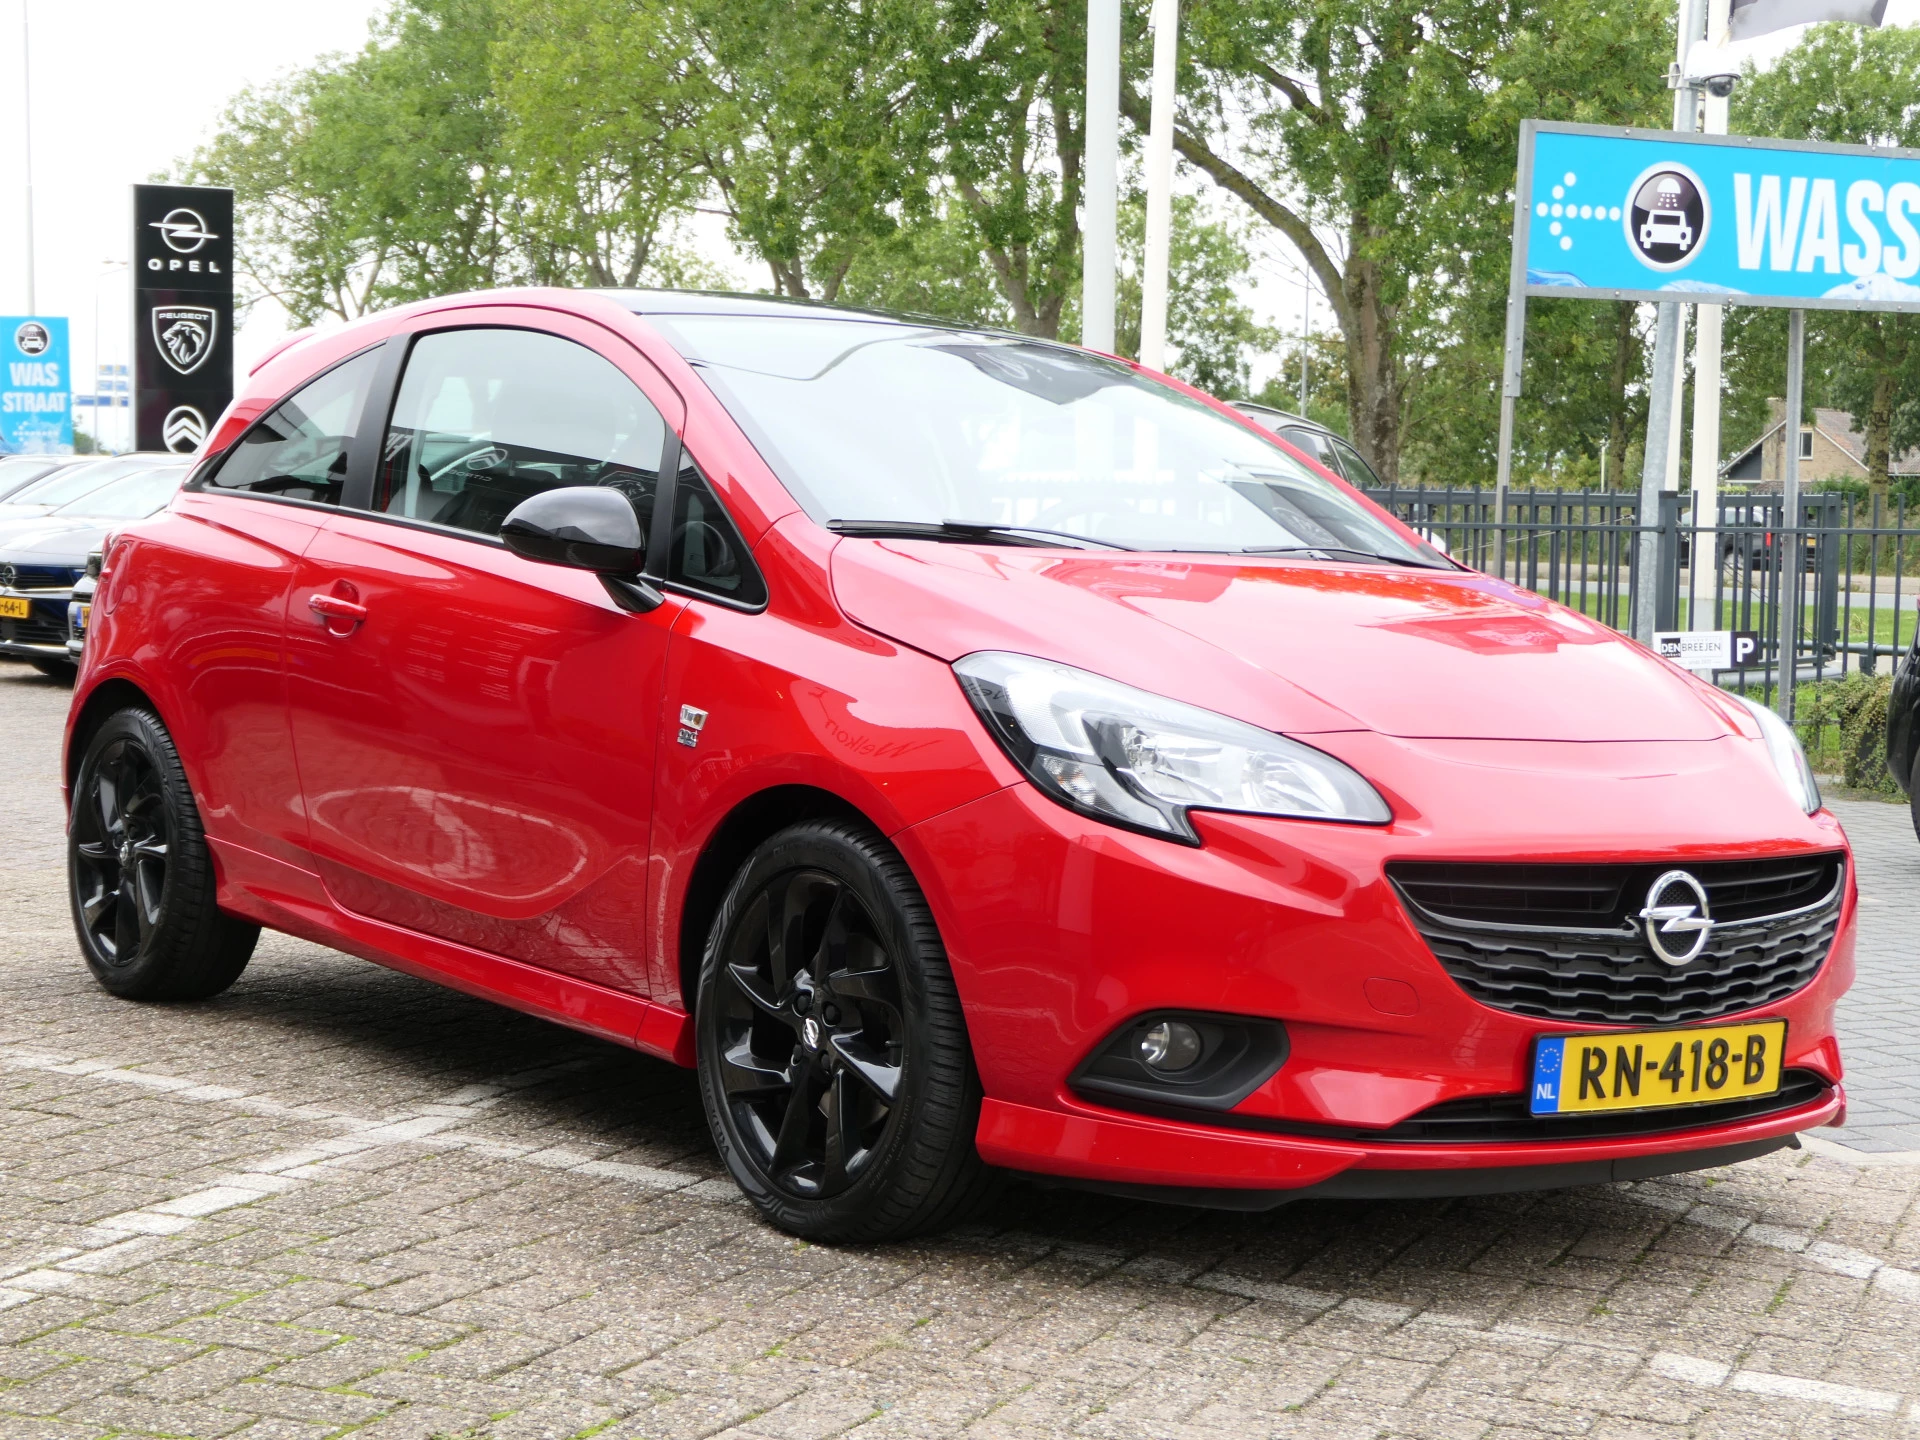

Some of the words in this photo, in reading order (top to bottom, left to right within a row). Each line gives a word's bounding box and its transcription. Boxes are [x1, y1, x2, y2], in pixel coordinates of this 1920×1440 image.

[1733, 173, 1920, 278] WASS
[147, 258, 222, 273] OPEL
[158, 312, 209, 320] PEUGEOT
[9, 361, 60, 387] WAS
[2, 391, 68, 413] STRAAT
[1661, 642, 1681, 653] DEN
[1681, 642, 1721, 652] BREEJEN
[1736, 637, 1755, 662] P
[1578, 1034, 1767, 1100] RN-418-B
[1535, 1083, 1556, 1100] NL
